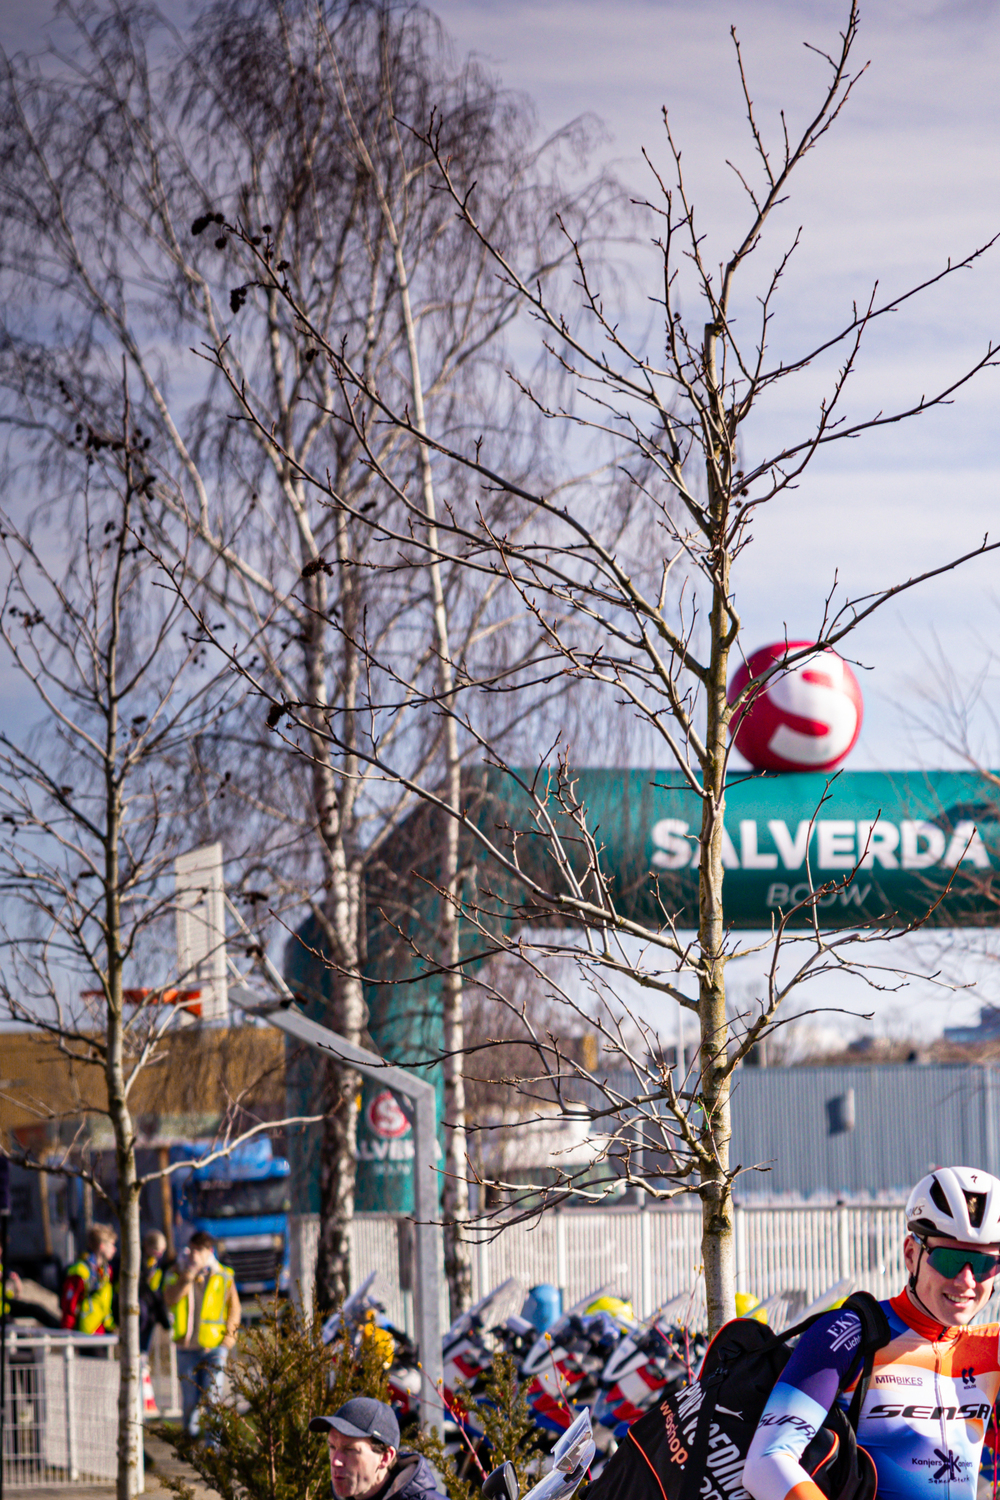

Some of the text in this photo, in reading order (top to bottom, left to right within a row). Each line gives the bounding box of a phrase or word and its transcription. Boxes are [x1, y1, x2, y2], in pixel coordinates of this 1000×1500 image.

[652, 818, 991, 870] SALVERDA
[766, 882, 873, 908] BOUW
[866, 1403, 991, 1420] SENSA
[911, 1457, 943, 1468] Kanjers
